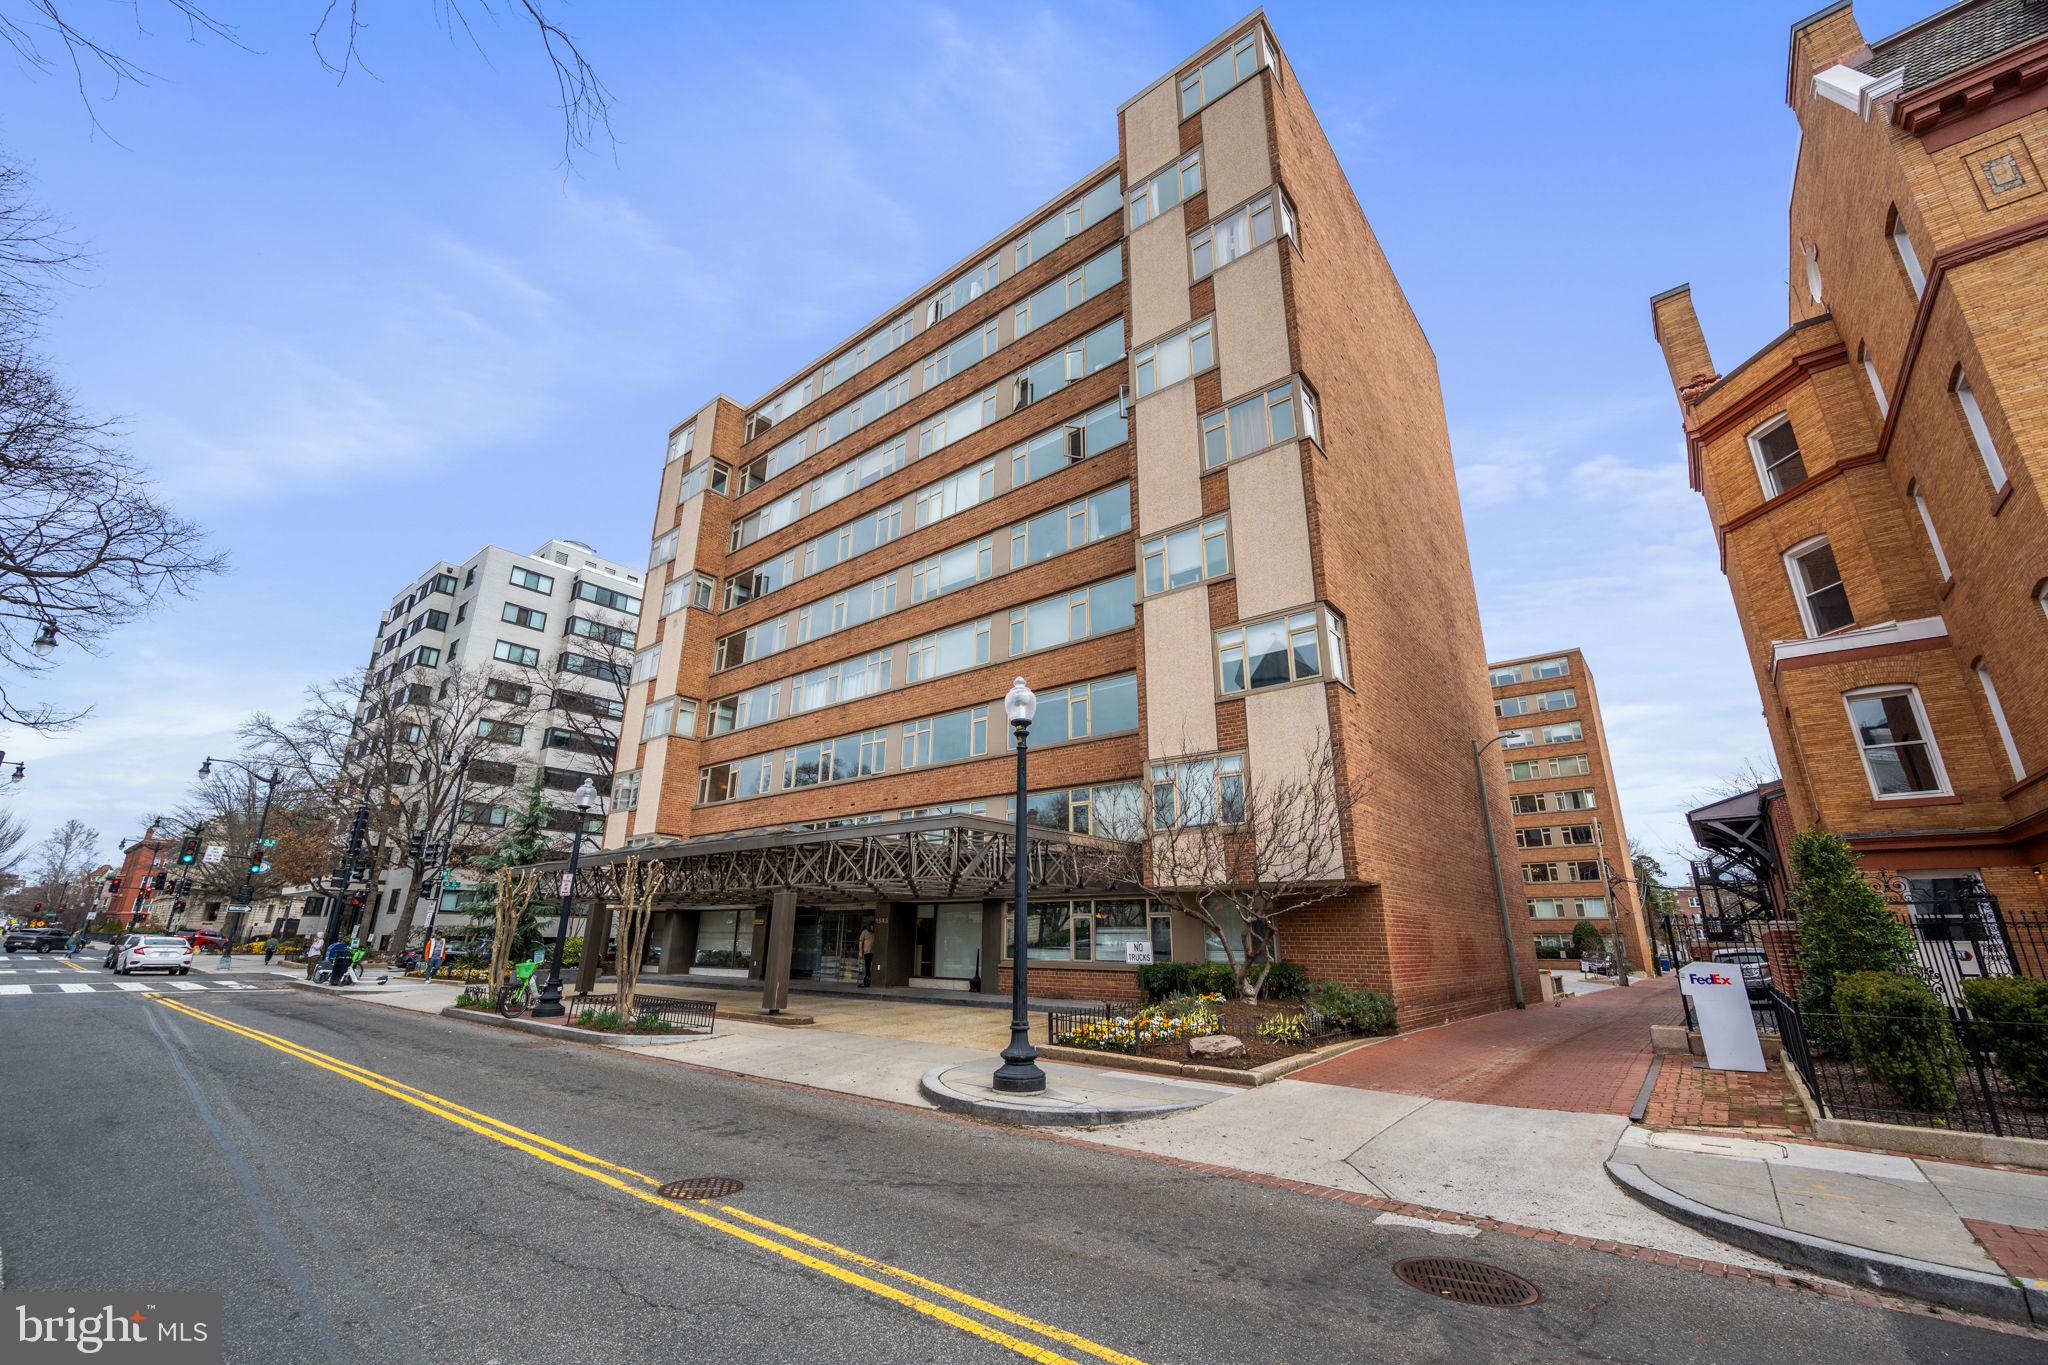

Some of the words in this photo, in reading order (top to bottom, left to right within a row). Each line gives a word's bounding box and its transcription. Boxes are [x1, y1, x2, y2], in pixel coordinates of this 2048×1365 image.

[1133, 943, 1144, 952] NO
[1128, 953, 1151, 962] TRUCKS
[1689, 973, 1732, 985] FedEx
